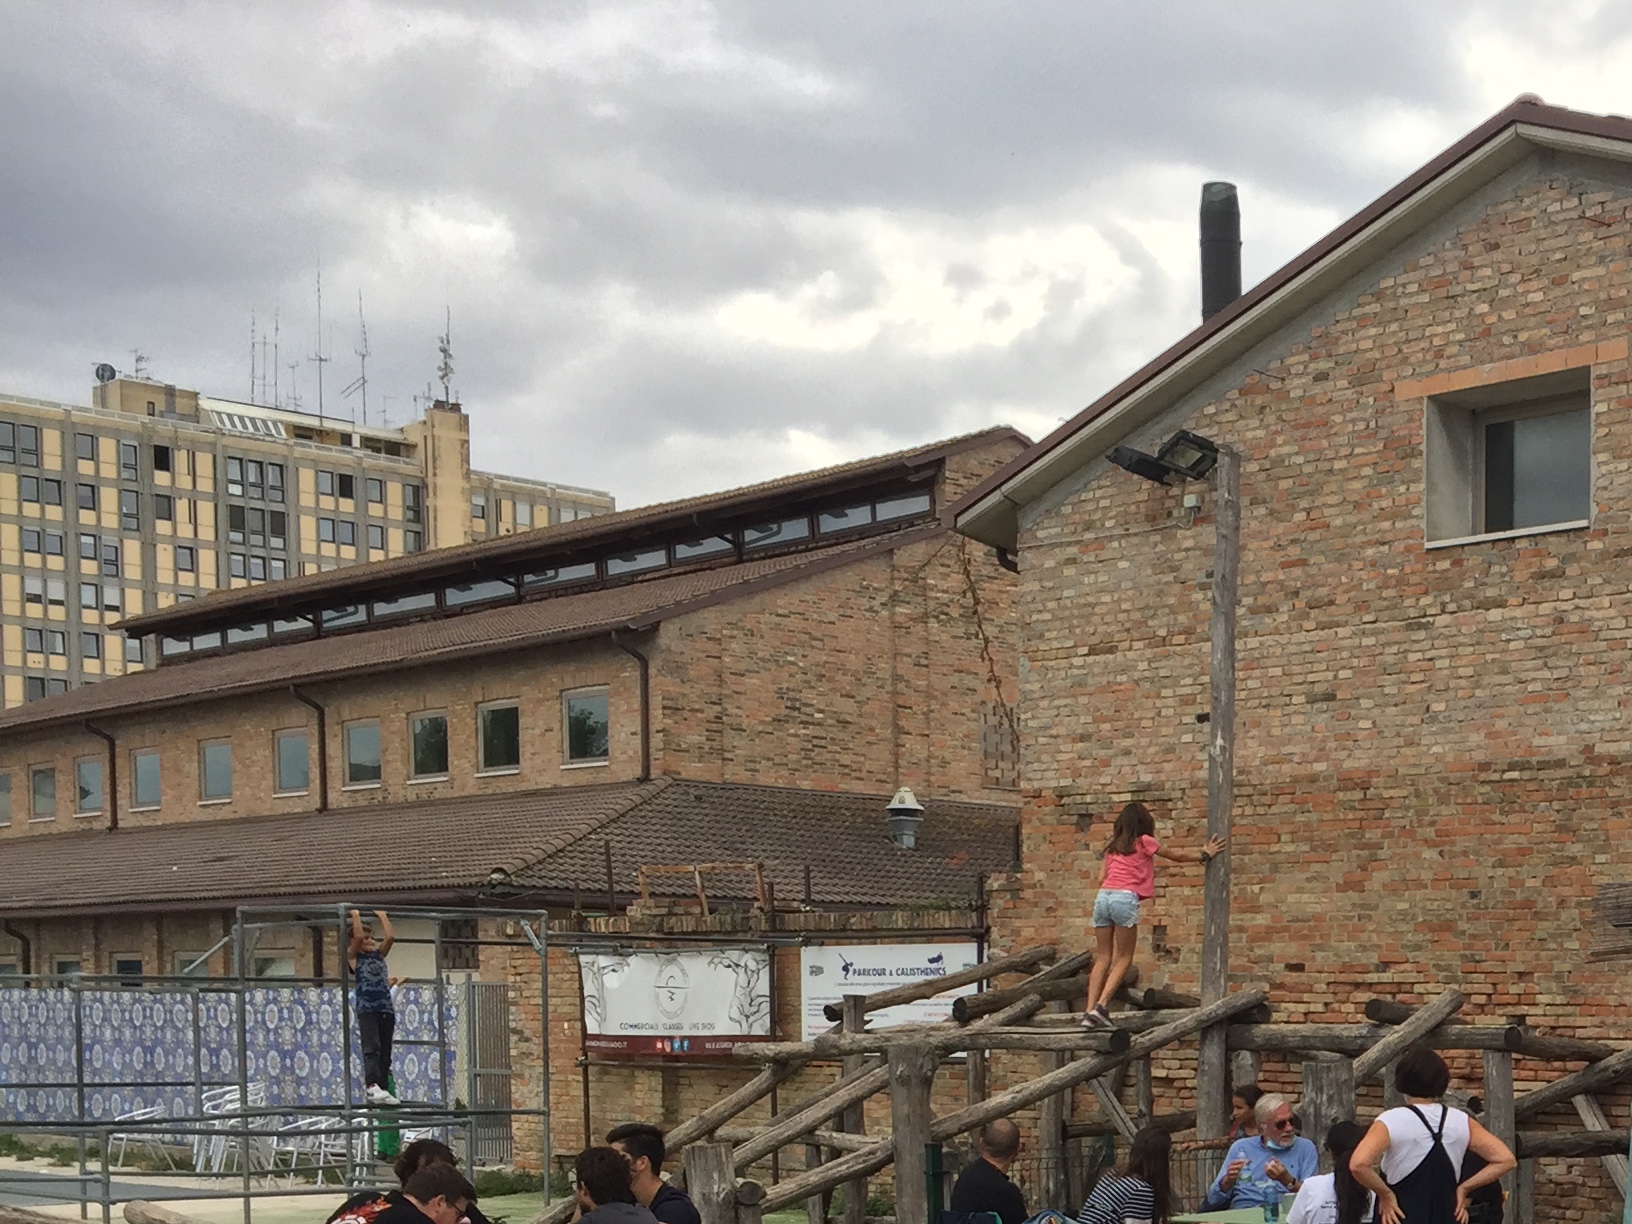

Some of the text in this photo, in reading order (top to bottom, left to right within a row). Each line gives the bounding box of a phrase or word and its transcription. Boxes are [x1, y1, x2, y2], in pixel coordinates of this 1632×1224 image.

[852, 968, 886, 977] PARKOUR
[895, 966, 947, 977] CALISTHENICS
[662, 1022, 684, 1031] CLASSES
